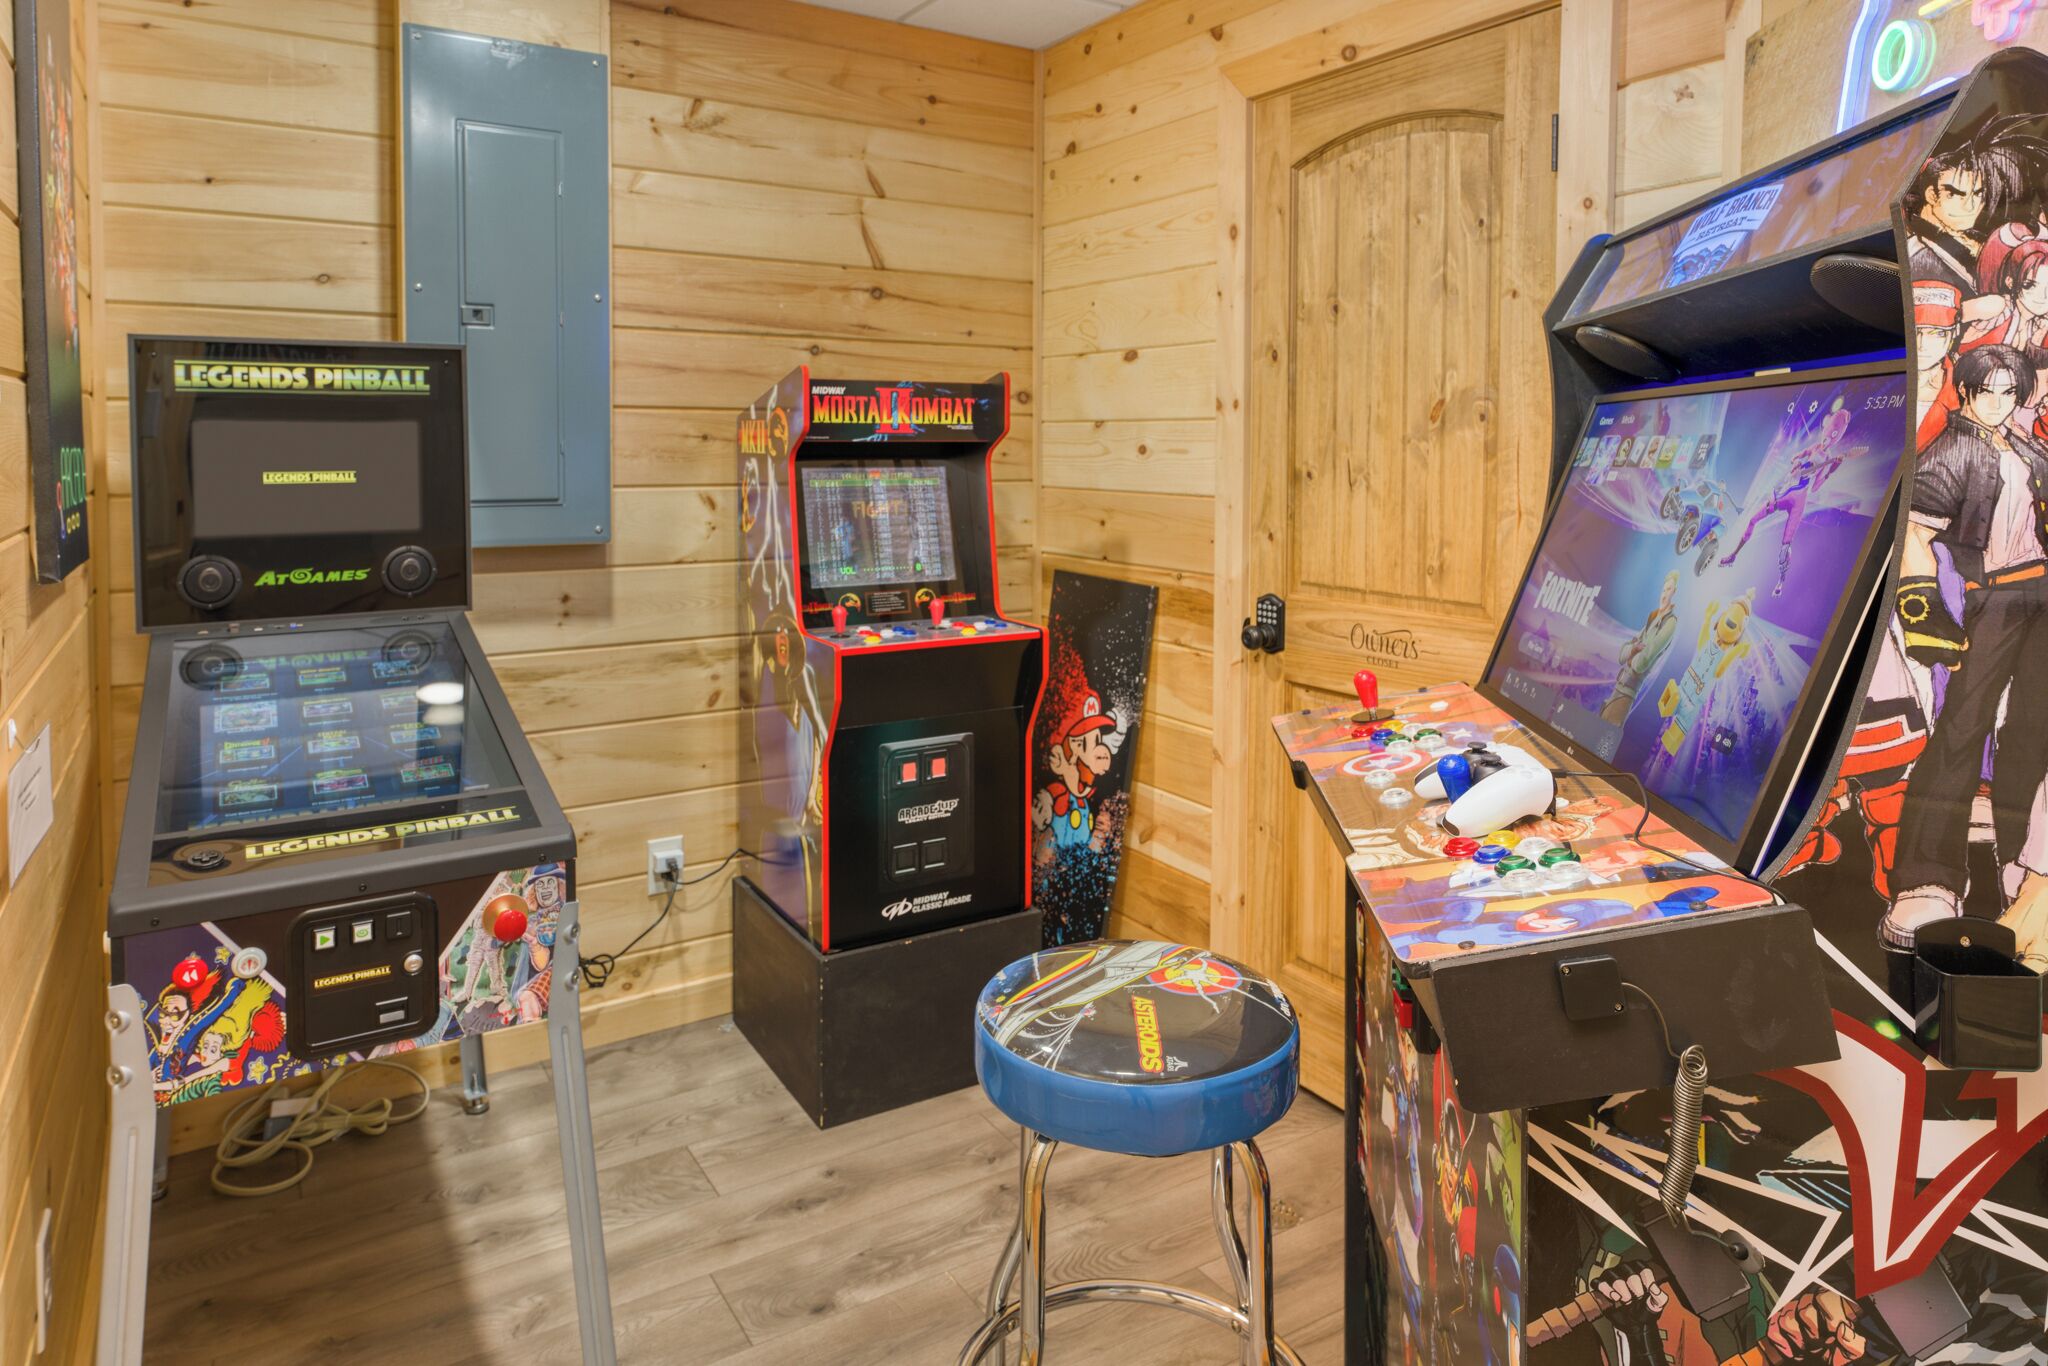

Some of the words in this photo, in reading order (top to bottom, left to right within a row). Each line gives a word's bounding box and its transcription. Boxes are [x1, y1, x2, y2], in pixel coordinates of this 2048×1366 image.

[1687, 201, 1730, 236] WOLF
[1724, 188, 1779, 218] BRANCH
[1697, 215, 1748, 240] RETREAT
[174, 363, 309, 390] LEGENDS
[314, 367, 431, 391] PINBALL
[811, 385, 846, 396] MIDWAY
[1864, 396, 1888, 411] 5:53
[1888, 394, 1906, 408] PM
[812, 395, 893, 424] MORTAL
[896, 397, 976, 425] KOMBAT
[262, 471, 311, 484] LEGENDS
[313, 470, 357, 483] PINBALL
[1533, 570, 1602, 626] FORTNITE
[1366, 655, 1400, 670] CLOSET
[245, 826, 390, 860] LEGENDS
[395, 806, 520, 839] PINBALL
[911, 900, 943, 914] CLASSIC
[943, 894, 972, 908] ARCADE
[913, 890, 950, 906] MIDWAY
[314, 973, 354, 989] LEGENDS
[354, 965, 392, 981] PINBALL
[1133, 994, 1164, 1072] ASTEROIDS
[1165, 1055, 1175, 1072] ATARI
